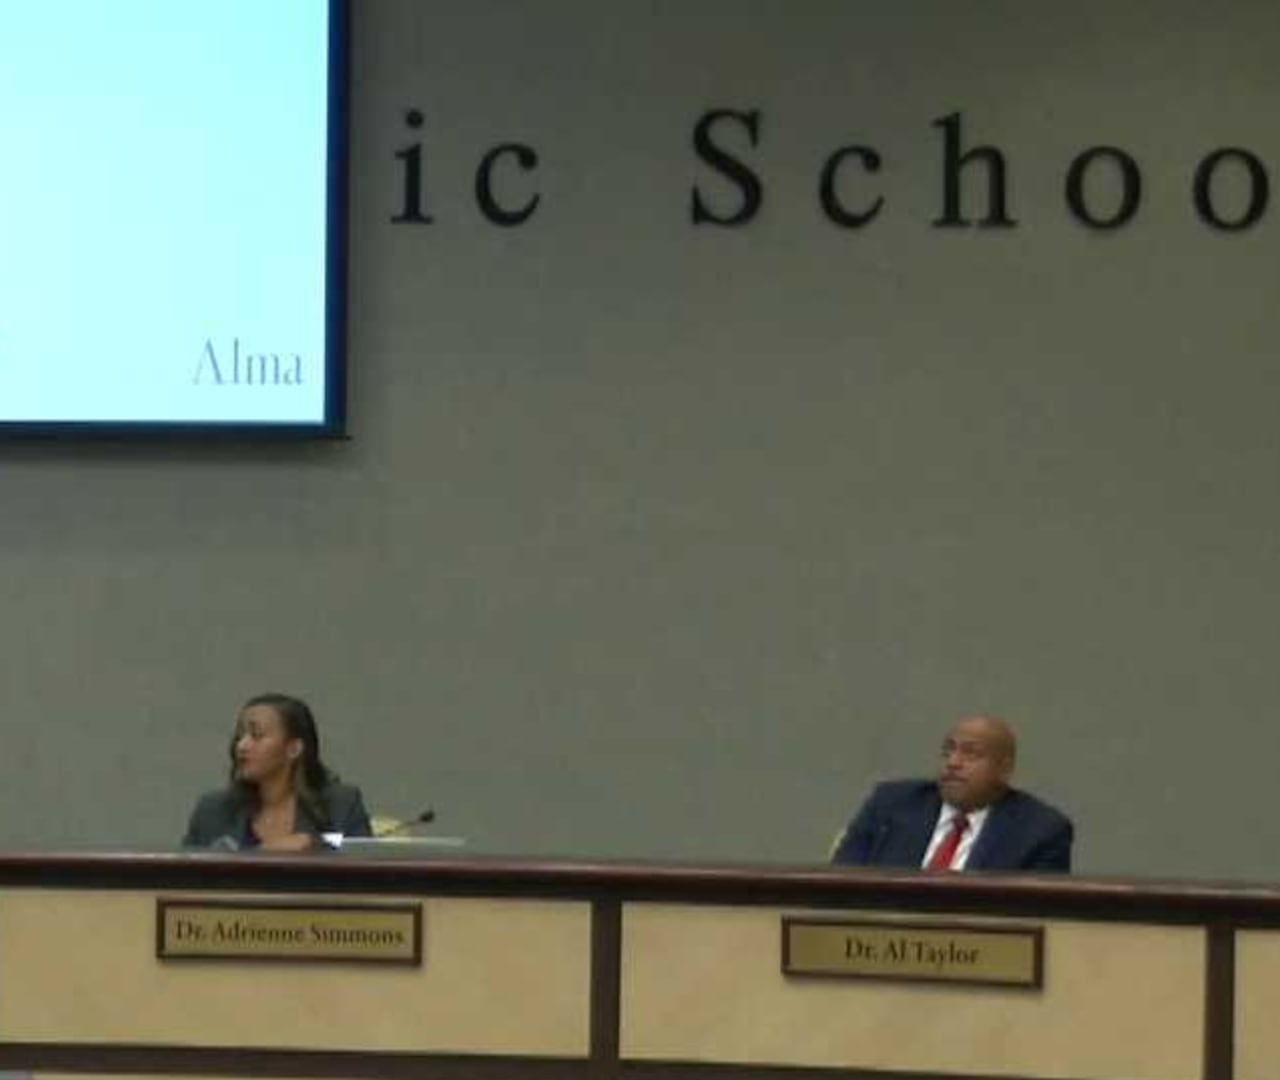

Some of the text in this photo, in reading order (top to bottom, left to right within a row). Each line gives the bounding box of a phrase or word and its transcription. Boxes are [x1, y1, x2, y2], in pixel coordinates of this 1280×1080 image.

[390, 108, 540, 228] ic
[690, 107, 1272, 233] Schoo
[192, 336, 304, 387] Alma
[175, 917, 406, 946] Dr. Adrienne Simmons
[845, 936, 981, 969] Dr. Al Taylor
